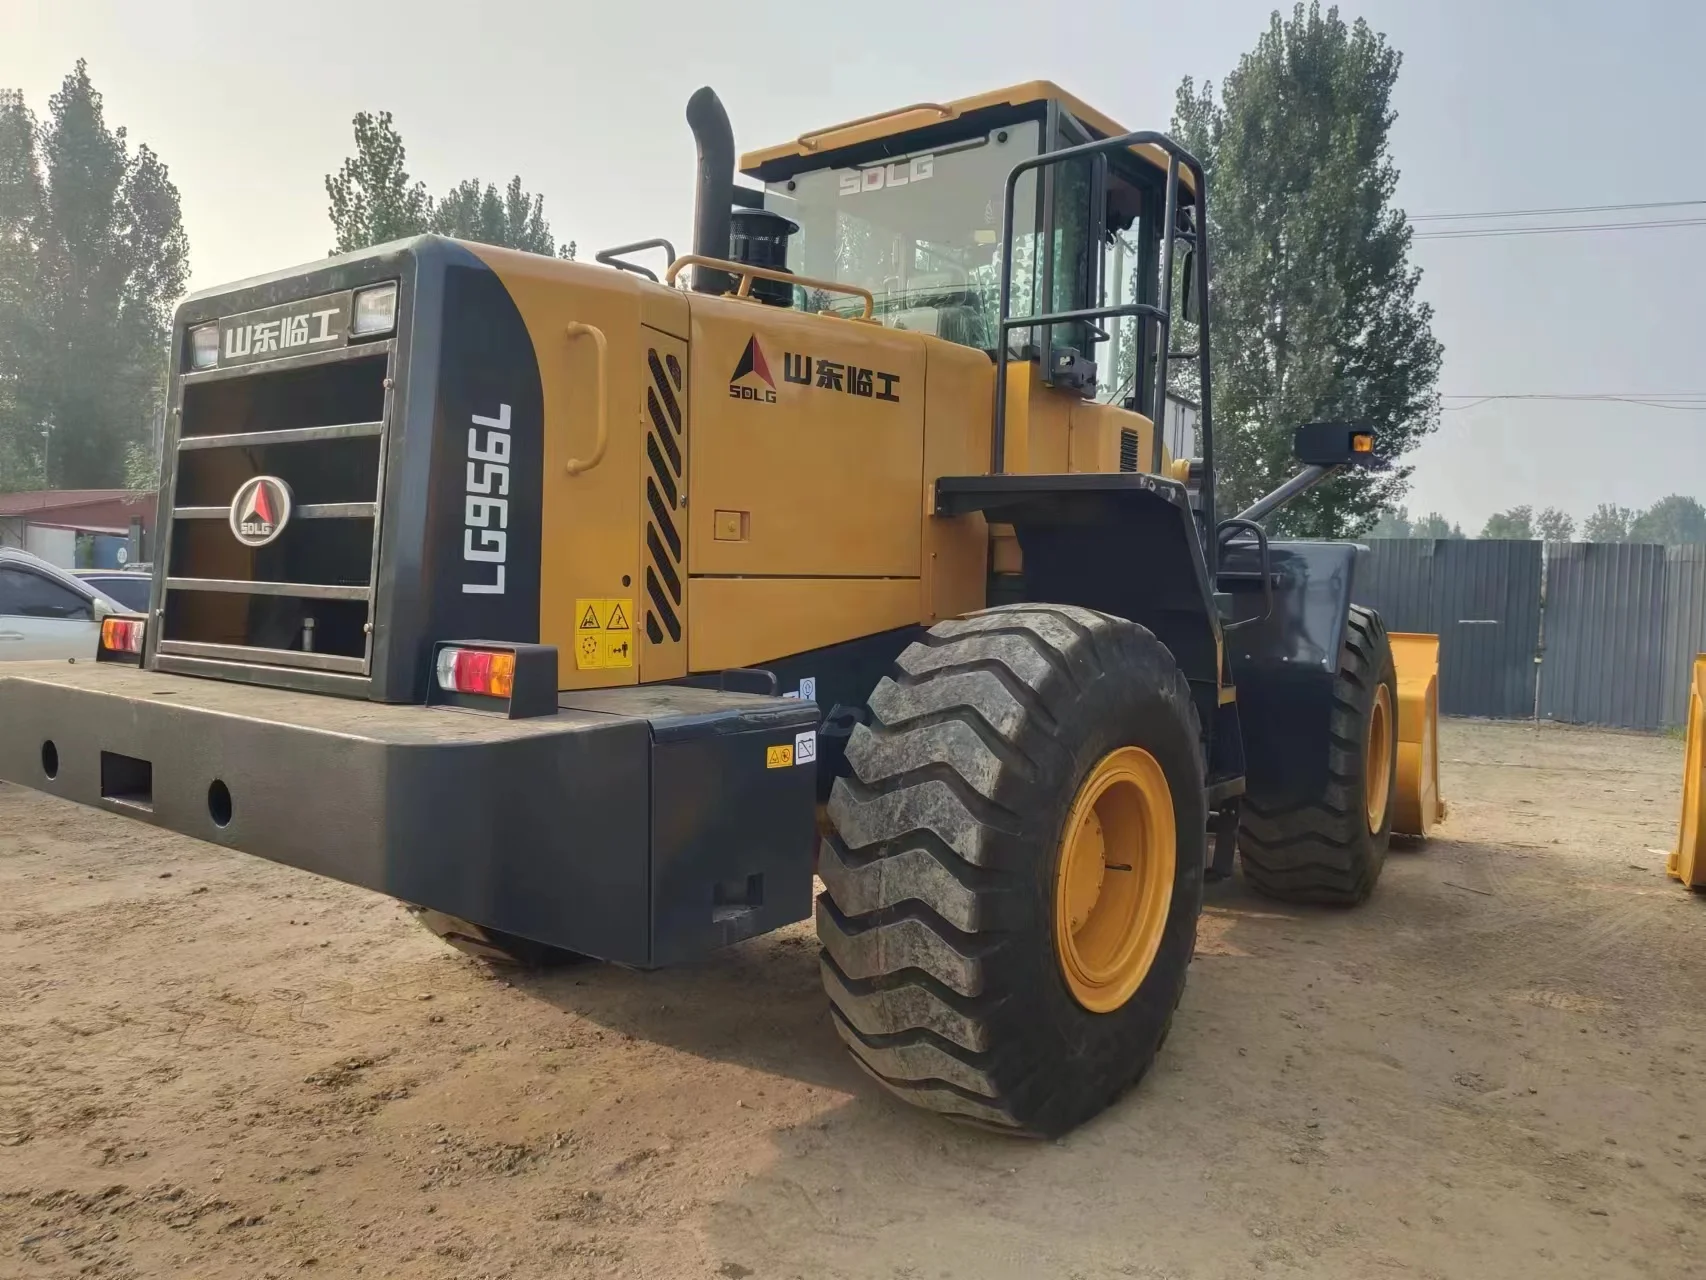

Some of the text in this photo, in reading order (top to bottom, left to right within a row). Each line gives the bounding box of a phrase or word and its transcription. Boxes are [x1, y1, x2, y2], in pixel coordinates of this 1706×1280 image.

[839, 155, 934, 196] SDLG
[225, 308, 340, 359] 山东临工
[730, 385, 776, 403] SDLG
[784, 352, 900, 402] 山东临工
[462, 403, 512, 594] LG956L
[241, 522, 271, 535] SDLG
